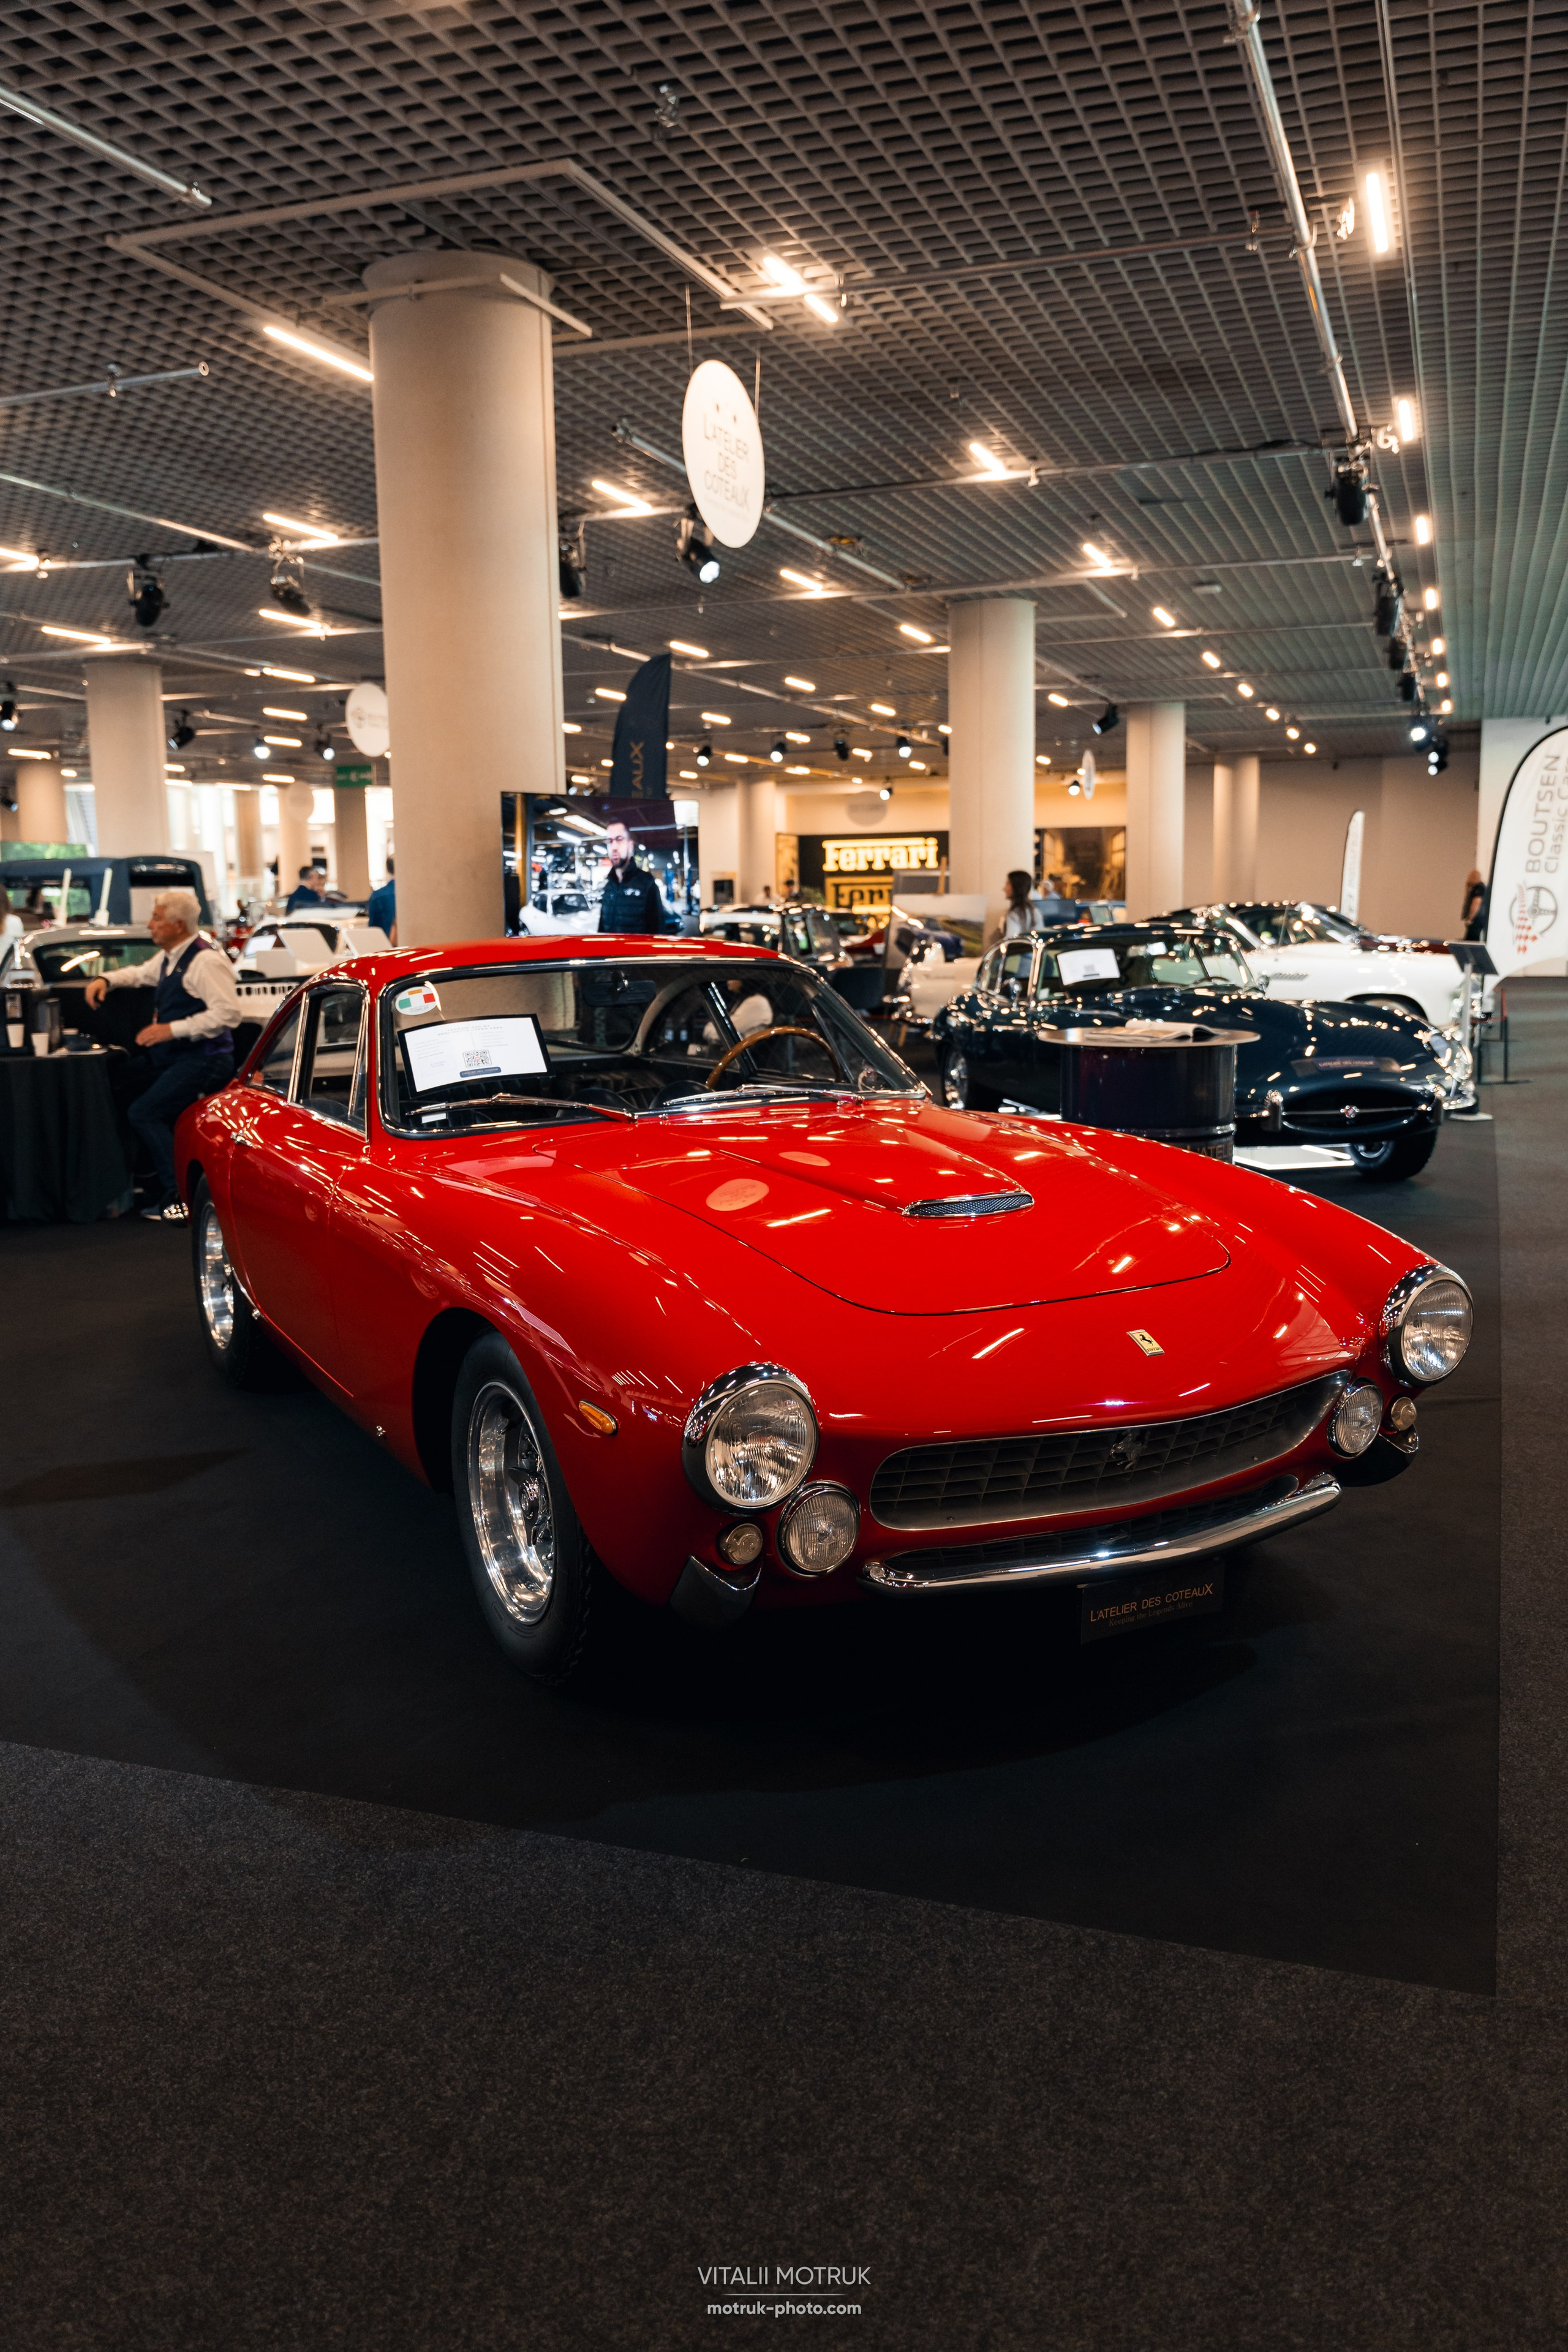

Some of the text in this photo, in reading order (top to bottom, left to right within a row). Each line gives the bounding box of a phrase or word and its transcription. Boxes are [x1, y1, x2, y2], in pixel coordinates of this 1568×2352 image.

[717, 451, 737, 480] DES
[704, 469, 750, 512] COTEAUX
[1525, 755, 1561, 873] BOUTSEN
[822, 837, 938, 872] Ferrari
[1544, 807, 1568, 873] Classic
[1090, 1583, 1213, 1623] L'ATELIER DES COTEAUX
[1109, 1601, 1193, 1627] Keeping the Legends Alive
